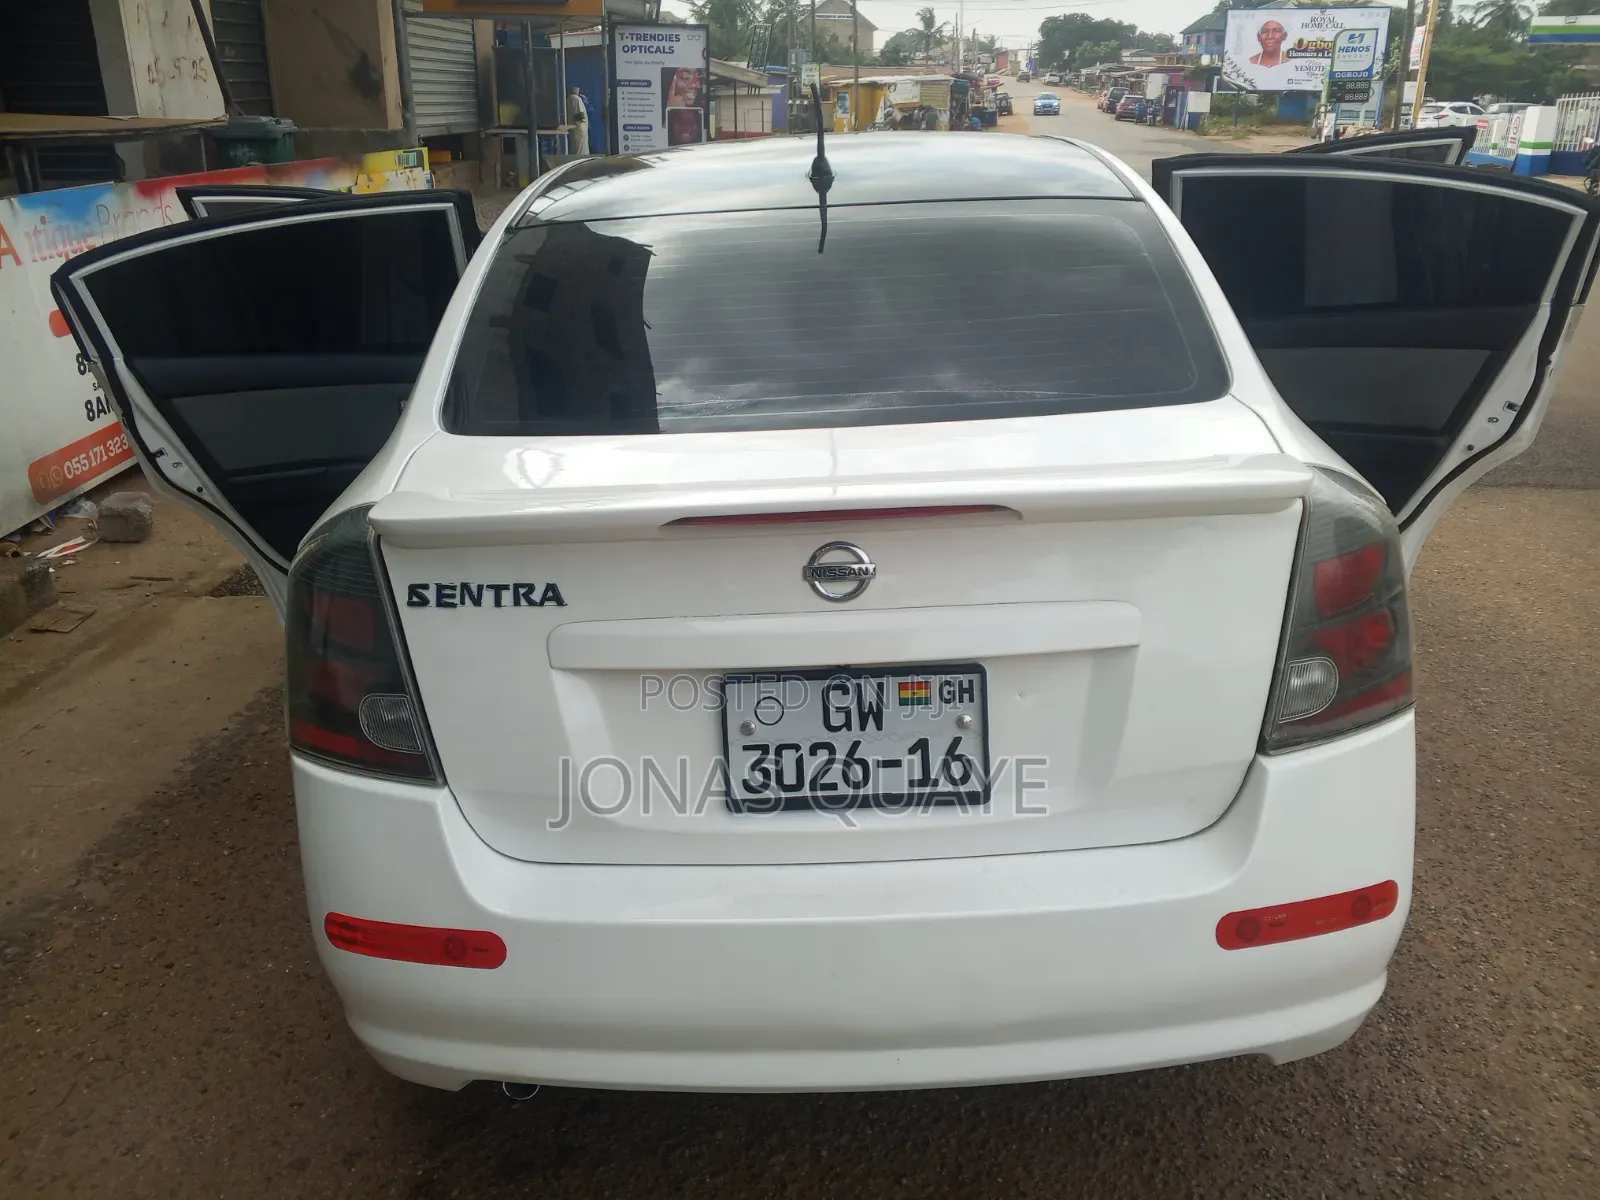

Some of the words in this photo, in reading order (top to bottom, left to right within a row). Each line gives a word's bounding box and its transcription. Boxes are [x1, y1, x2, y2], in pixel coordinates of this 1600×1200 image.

[619, 32, 681, 42] T-TRENDIES
[1293, 37, 1333, 52] Ogbo
[622, 44, 675, 54] OPTICALS
[1338, 45, 1371, 53] HENOS
[63, 453, 90, 479] 055
[811, 566, 869, 578] NISSAN
[406, 582, 568, 608] SENTRA
[822, 682, 884, 732] GW
[938, 679, 975, 704] GH
[741, 737, 973, 794] 3026-16
